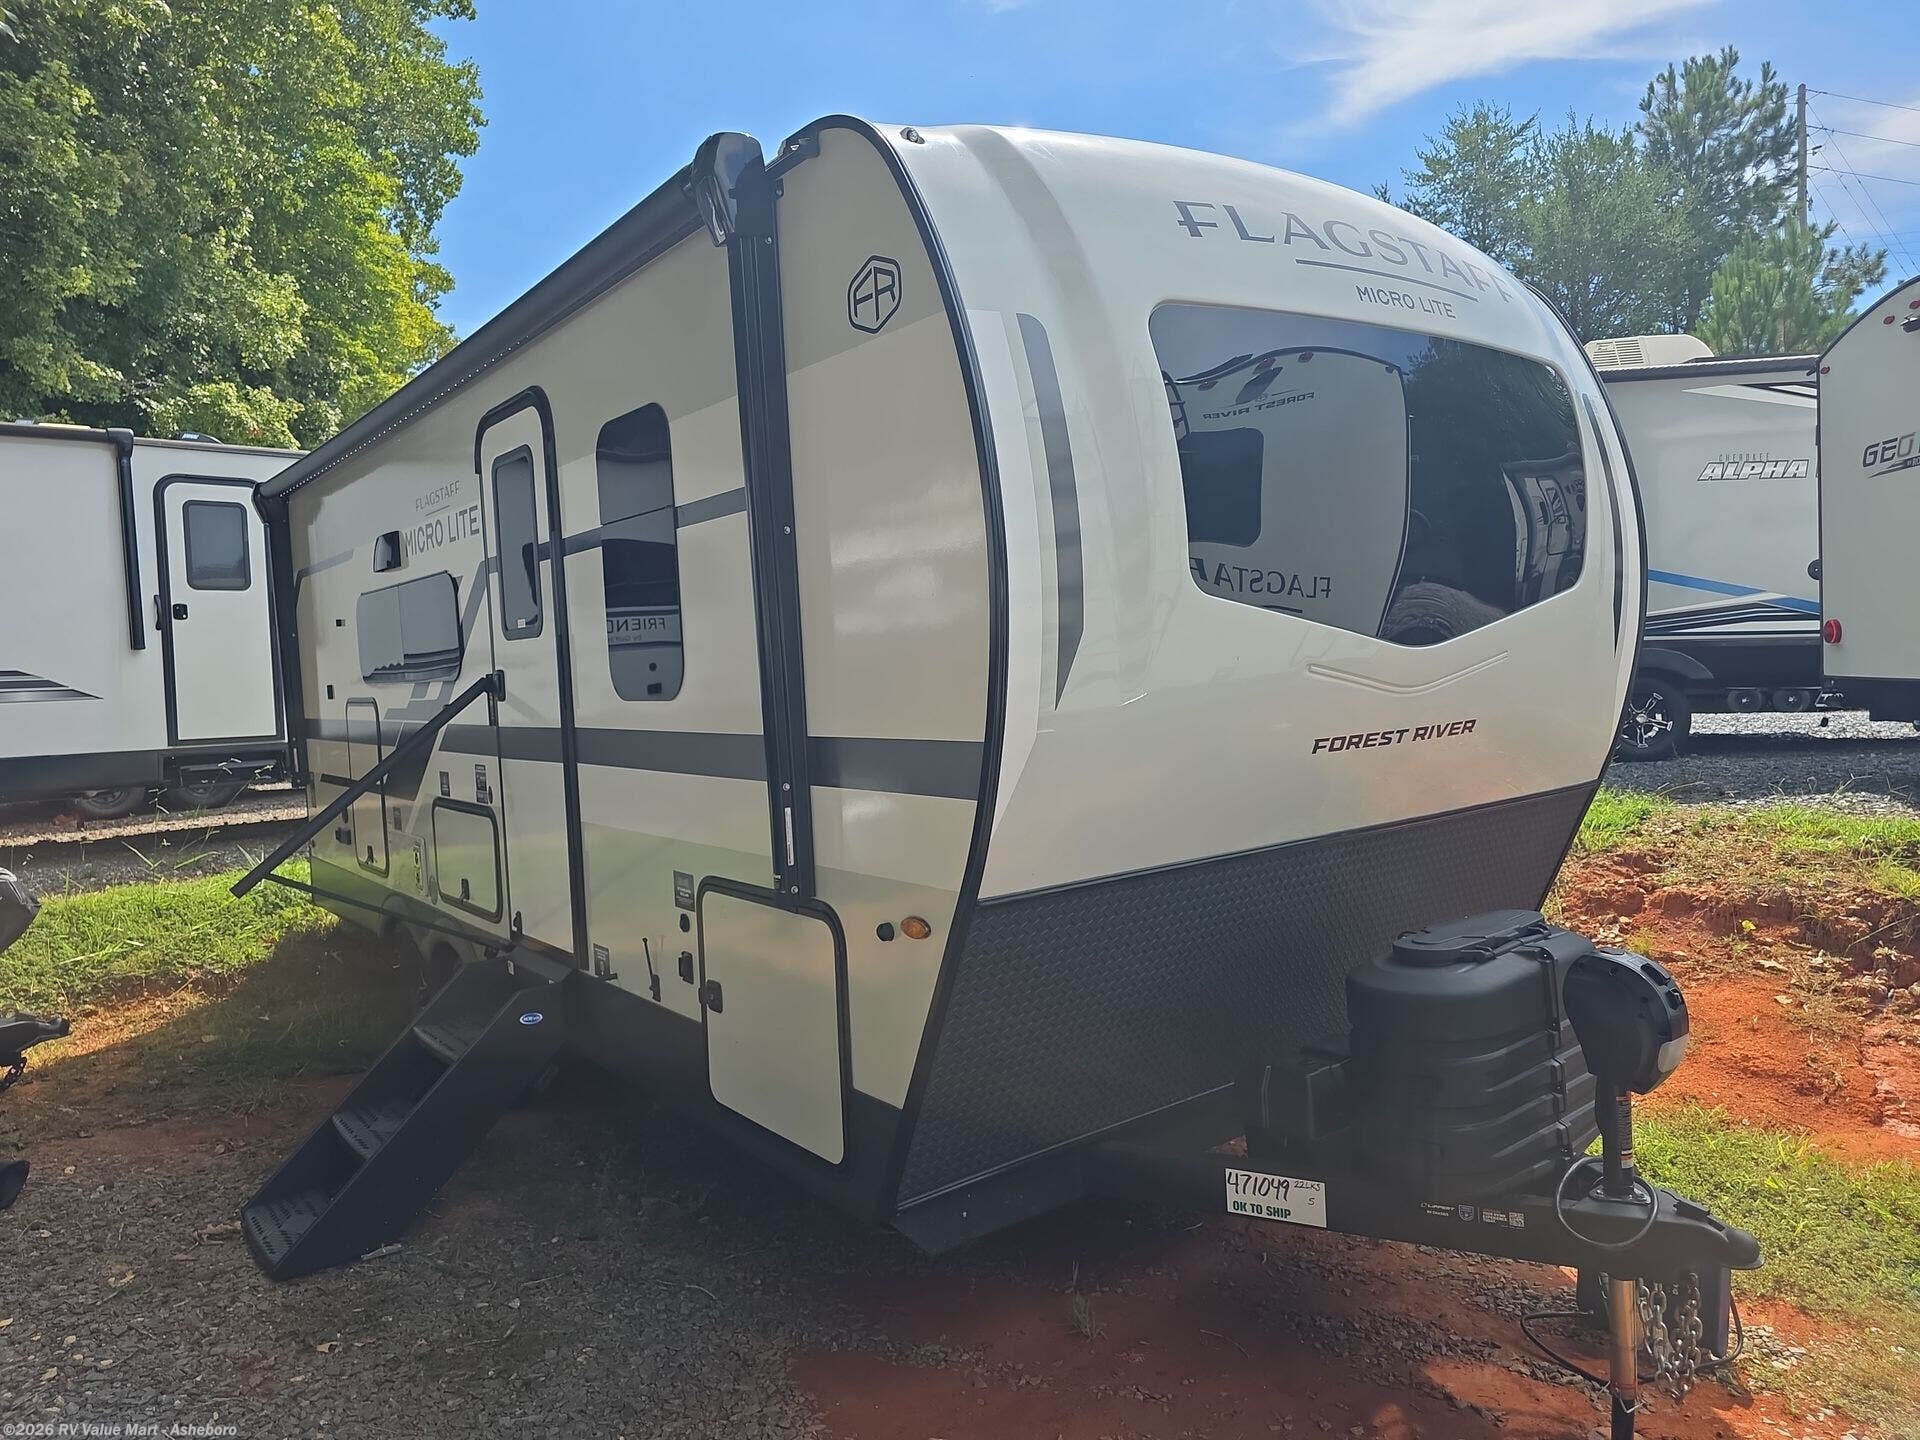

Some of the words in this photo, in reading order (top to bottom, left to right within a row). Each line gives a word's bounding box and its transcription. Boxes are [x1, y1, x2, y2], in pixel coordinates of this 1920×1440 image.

[1172, 200, 1514, 303] FLAGSTAFF
[1355, 285, 1415, 310] MICRO
[1419, 296, 1457, 319] LITE
[1862, 431, 1920, 468] GEO
[1697, 459, 1809, 481] ALPHA
[415, 480, 460, 512] FLAGSTAFF
[405, 519, 443, 557] MICRO
[448, 505, 480, 543] LITE
[1312, 728, 1410, 755] FOREST
[1412, 719, 1477, 742] RIVER
[1227, 1171, 1290, 1202] 471049
[1232, 1200, 1249, 1212] OK
[1250, 1203, 1263, 1215] TO
[1266, 1206, 1292, 1219] SHIP
